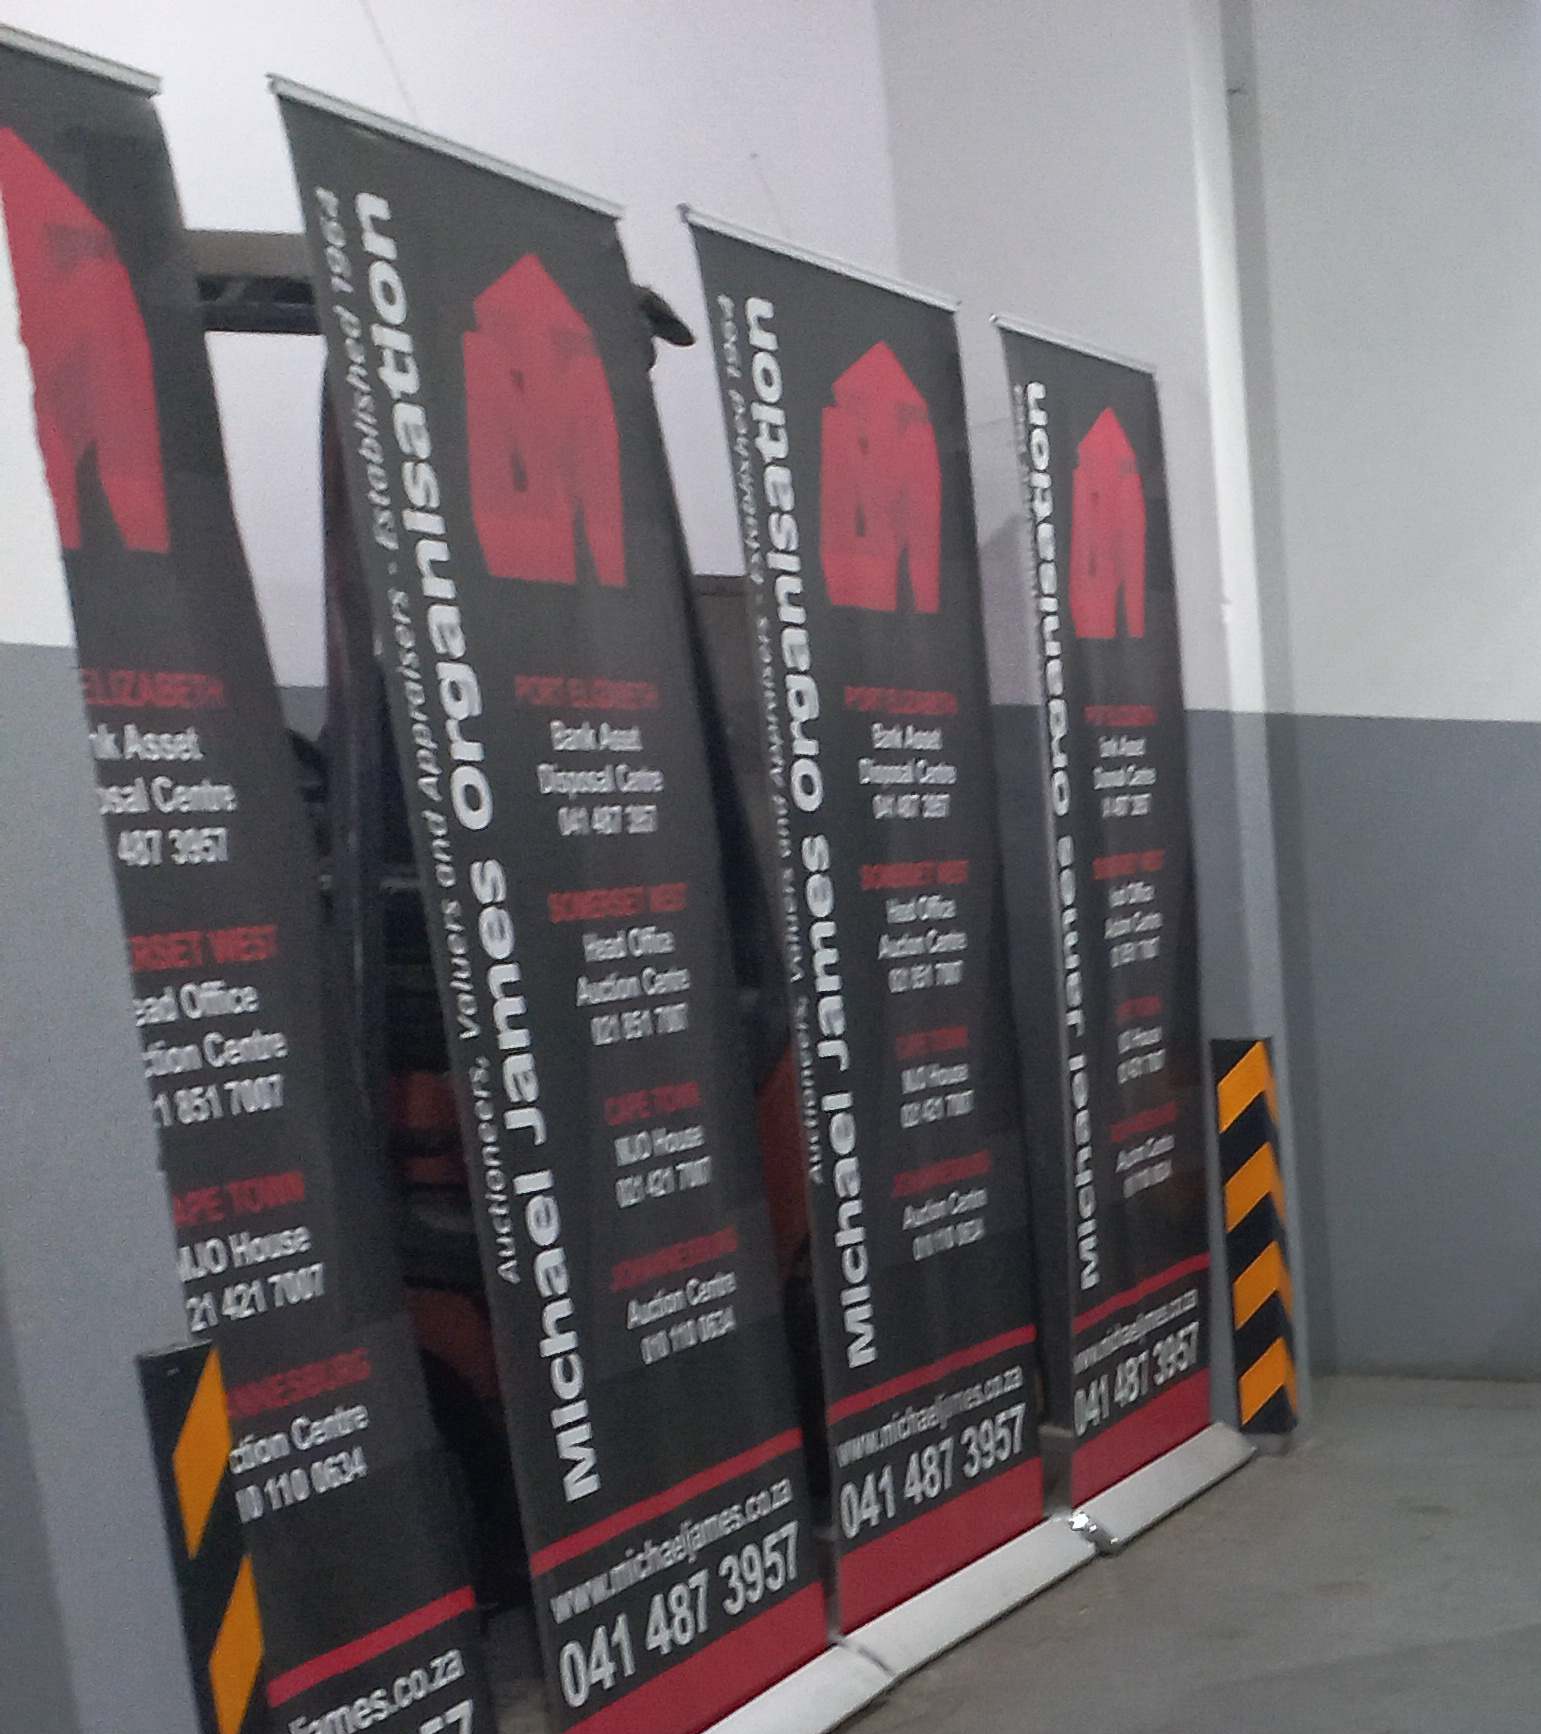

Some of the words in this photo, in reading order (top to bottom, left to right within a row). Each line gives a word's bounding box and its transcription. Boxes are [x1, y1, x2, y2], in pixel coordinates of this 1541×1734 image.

[332, 304, 398, 551] Established
[354, 190, 494, 831] Organisation
[745, 296, 824, 812] Organisation
[1026, 381, 1071, 817] Organisation
[151, 776, 237, 813] Centre
[387, 587, 443, 802] Appraisers
[422, 809, 456, 888] and
[801, 834, 850, 1072] James
[1057, 834, 1085, 1037] James
[180, 980, 260, 1019] Office
[203, 1029, 289, 1068] Centre
[470, 858, 547, 1147] James
[228, 1226, 313, 1269] House
[820, 1091, 879, 1369] Michael
[1067, 1053, 1101, 1291] Michael
[291, 1402, 370, 1451] Centre
[513, 1169, 601, 1502] Michael
[1074, 1374, 1110, 1437] 041
[1113, 1350, 1149, 1408] 487
[839, 1464, 896, 1539] 041
[904, 1438, 953, 1504] 487
[960, 1402, 1026, 1478] 3957
[559, 1612, 635, 1708] 041
[645, 1568, 709, 1654] 487
[718, 1520, 798, 1616] 3957
